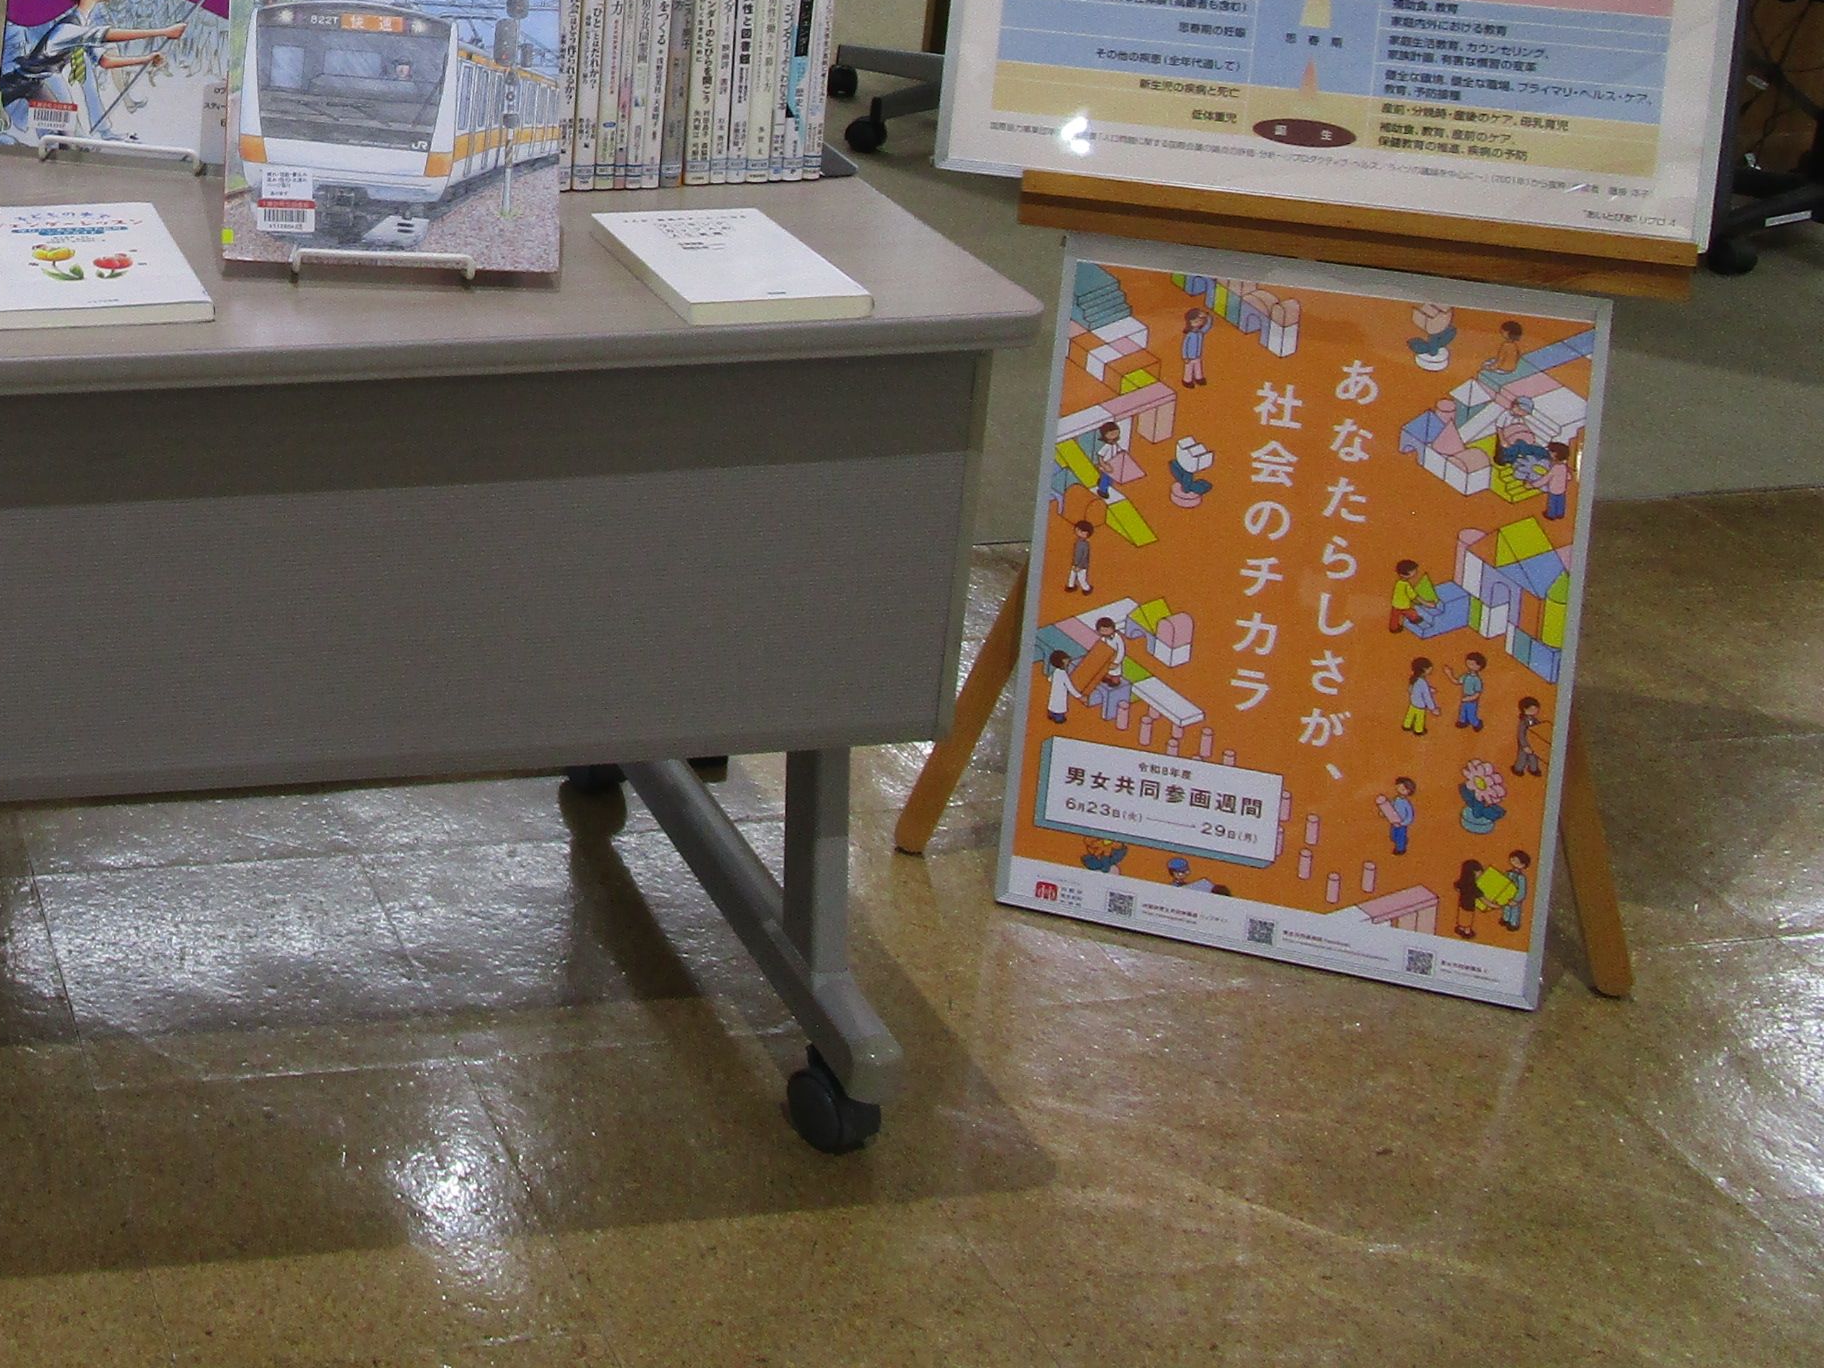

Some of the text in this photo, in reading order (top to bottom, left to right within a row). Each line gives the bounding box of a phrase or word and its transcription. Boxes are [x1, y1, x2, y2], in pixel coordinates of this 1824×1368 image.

[1229, 381, 1304, 713] 社会のチカラ
[1298, 358, 1380, 781] あなたらしさが、
[1064, 765, 1264, 819] 男女共同参画週間
